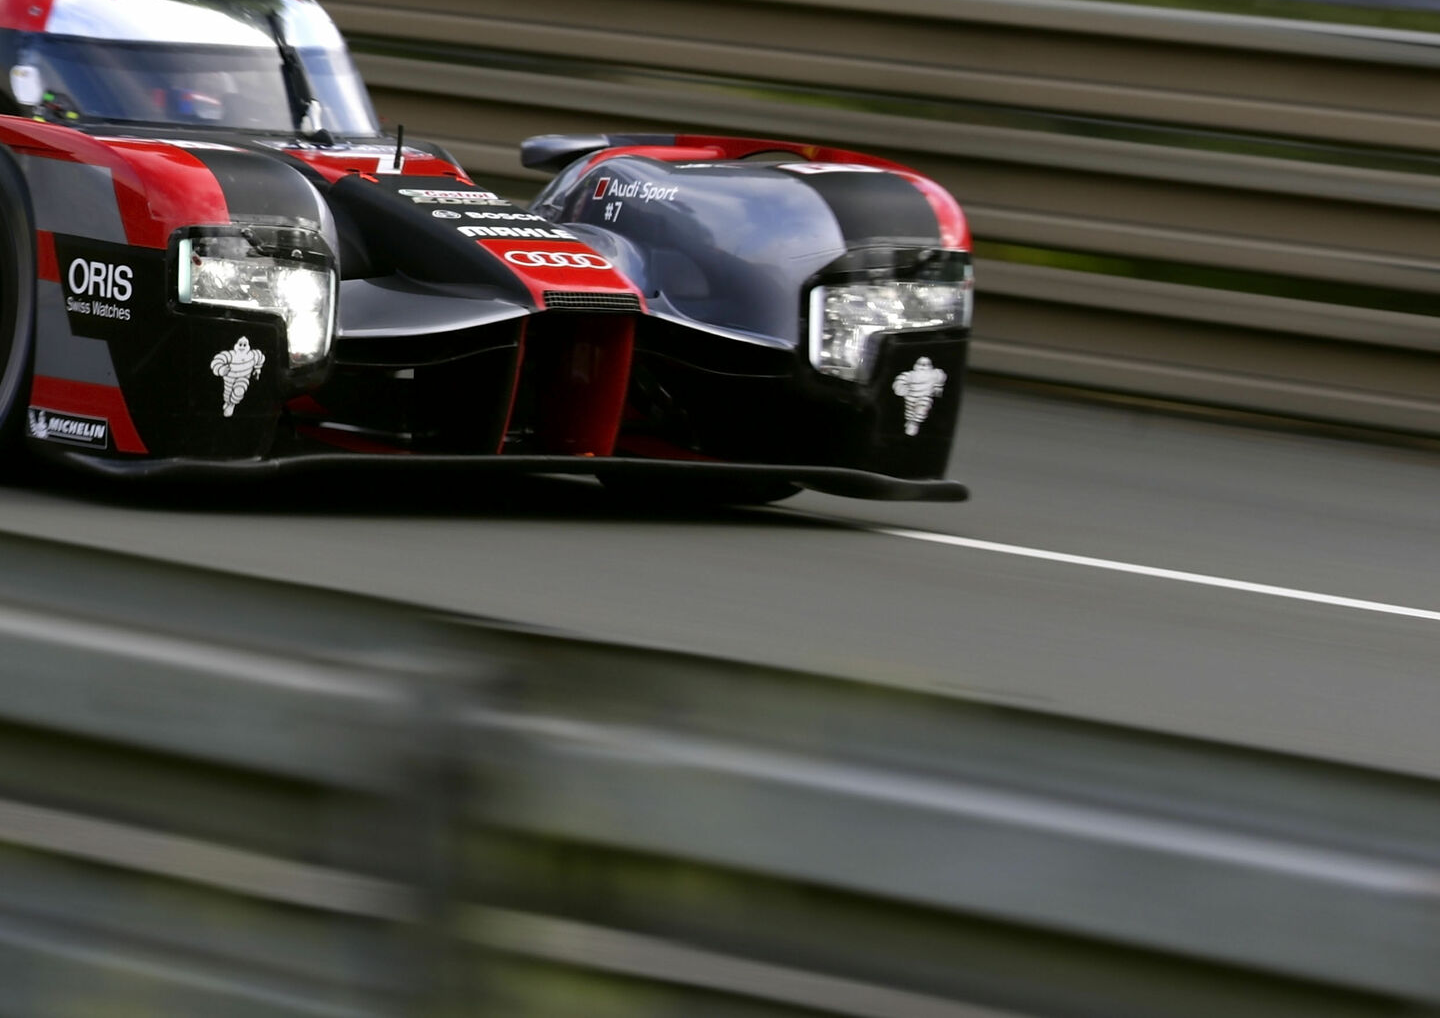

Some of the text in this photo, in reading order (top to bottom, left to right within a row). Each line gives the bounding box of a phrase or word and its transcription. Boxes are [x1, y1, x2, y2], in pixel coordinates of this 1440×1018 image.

[424, 190, 491, 200] Castrol
[608, 179, 679, 203] Audi Sport
[464, 211, 547, 222] BOSCH
[604, 202, 622, 222] #7
[457, 226, 578, 240] MAHLE
[68, 257, 133, 302] ORIS
[66, 296, 131, 321] Swiss Watches
[48, 417, 106, 439] MICHELIN
